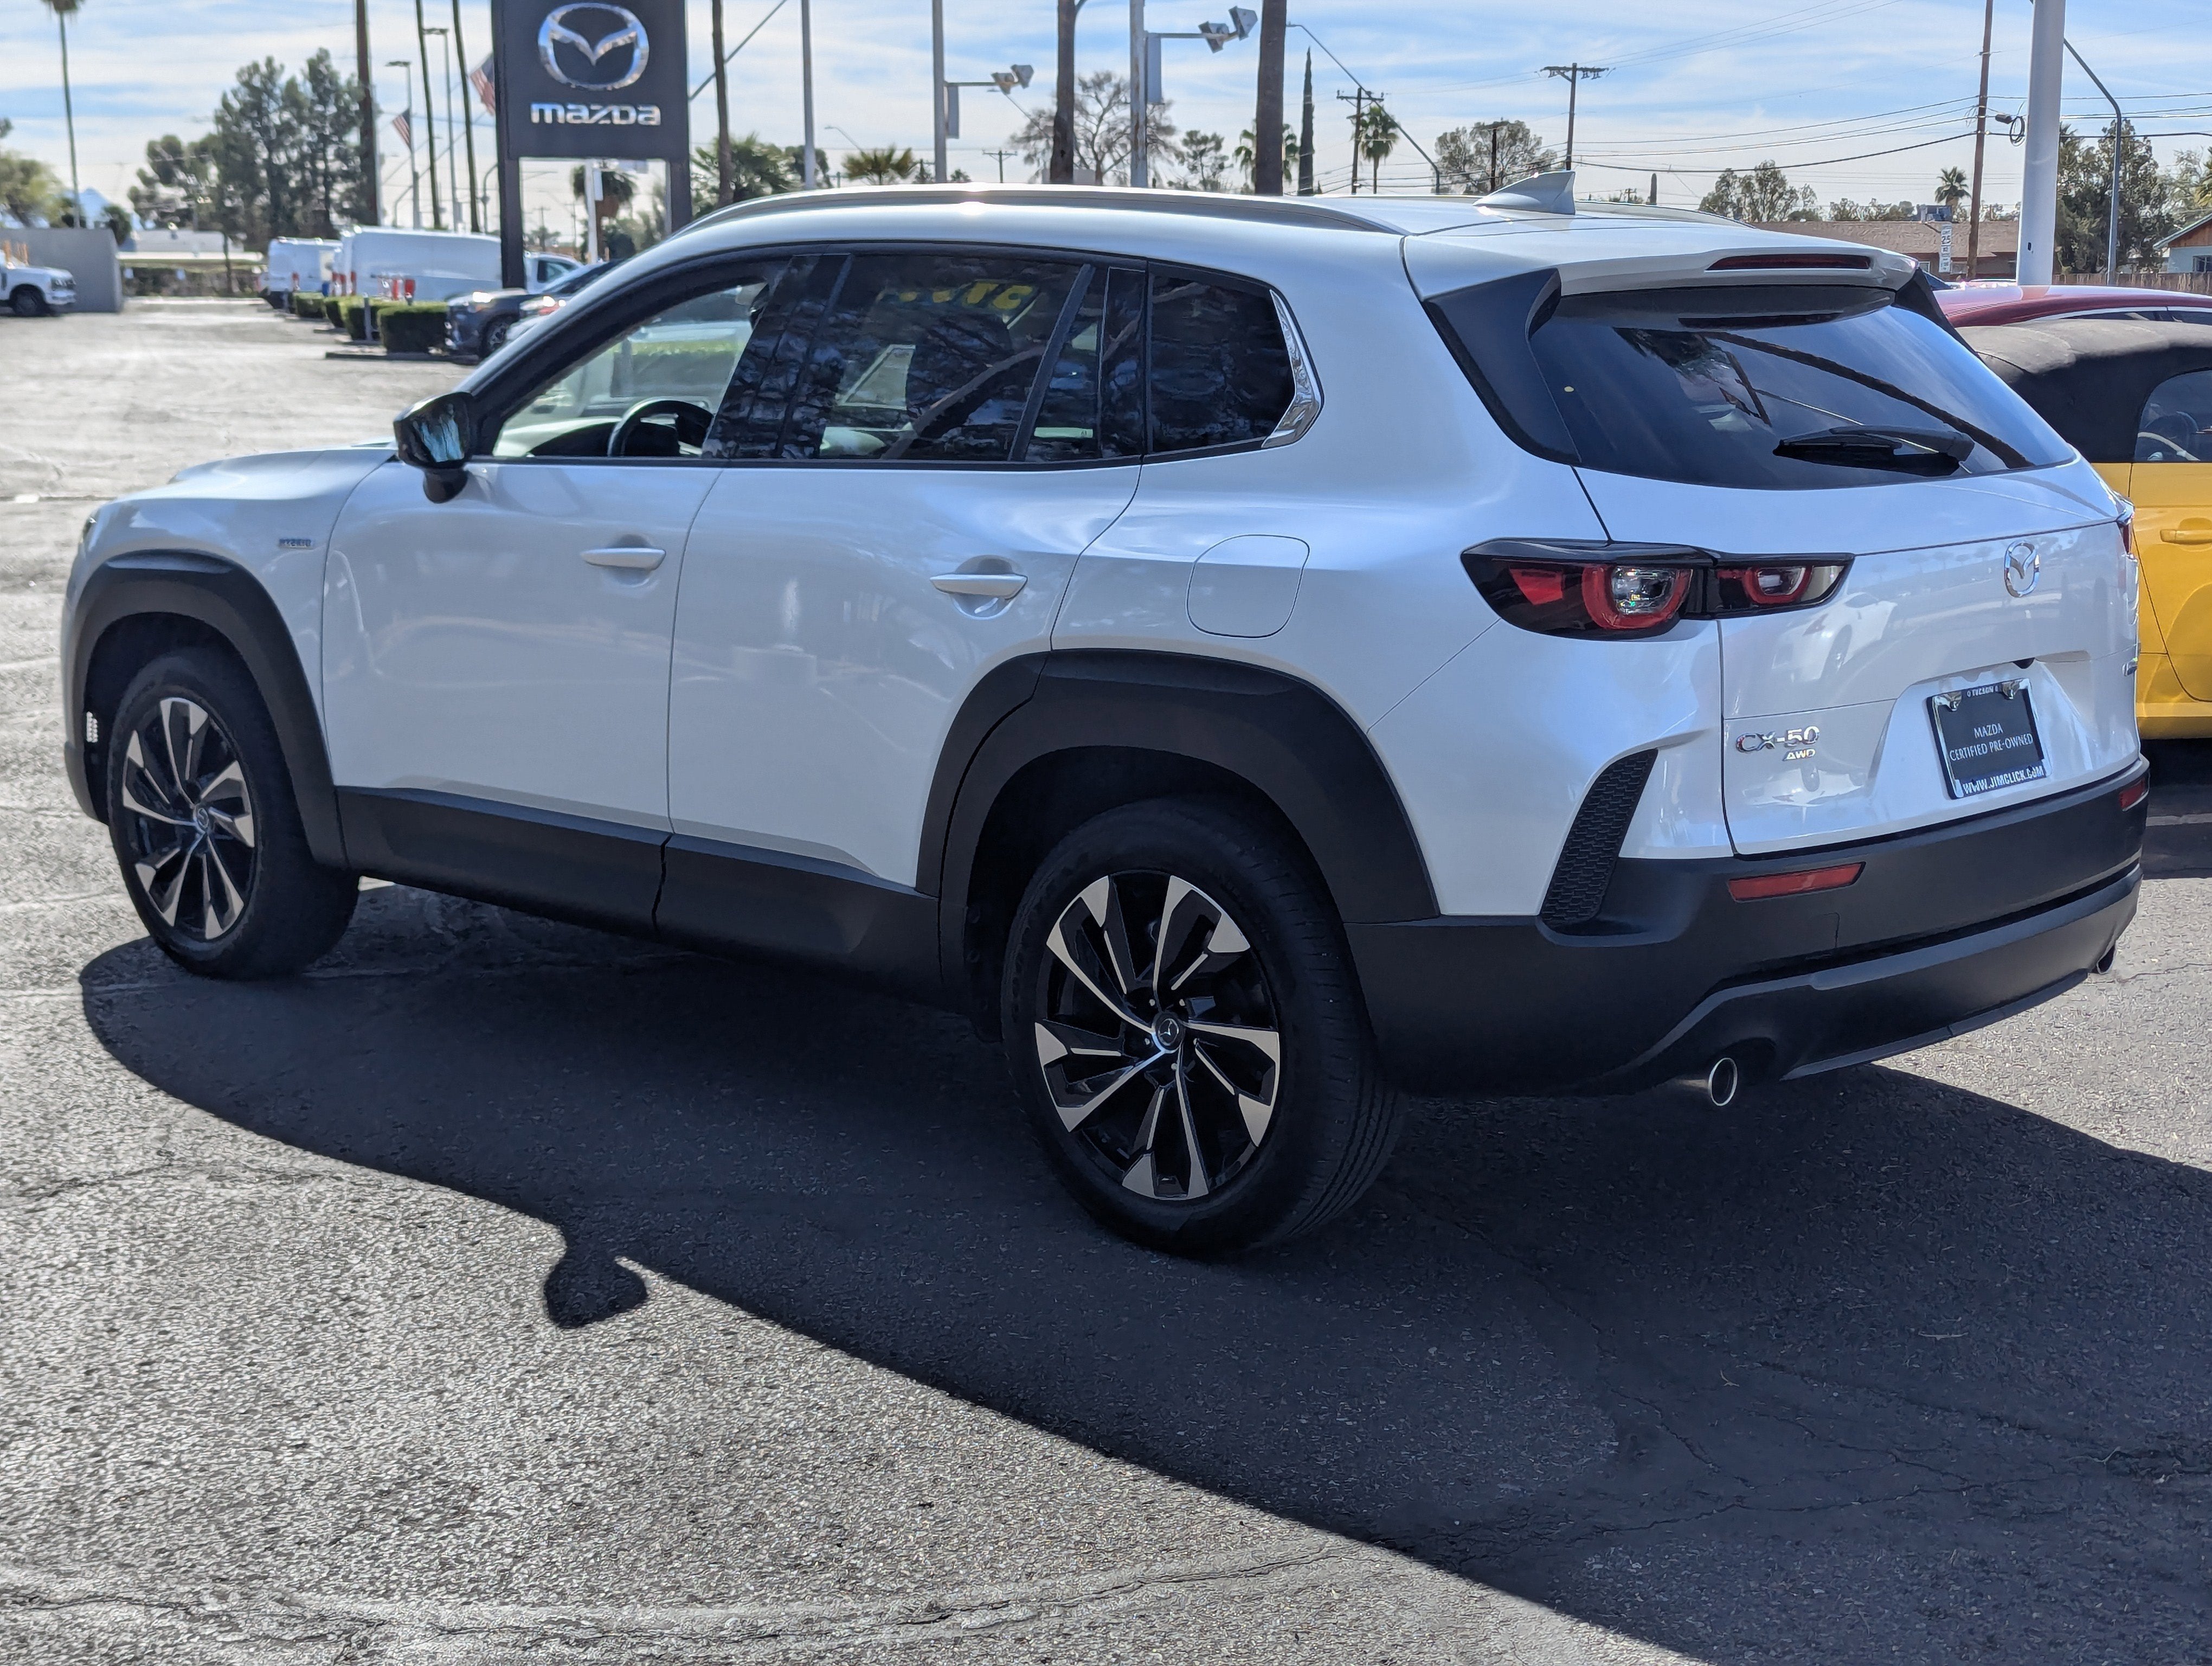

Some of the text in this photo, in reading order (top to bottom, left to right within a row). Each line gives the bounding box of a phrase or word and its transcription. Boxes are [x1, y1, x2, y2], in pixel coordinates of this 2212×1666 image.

[1736, 726, 1820, 753] CX-50
[1973, 723, 2003, 739] MAZDA
[1783, 749, 1816, 761] AWD
[1949, 733, 2033, 761] CERTIFIED PRE-OWNED
[1962, 765, 2044, 794] WWW.JIMCLICK.COM
